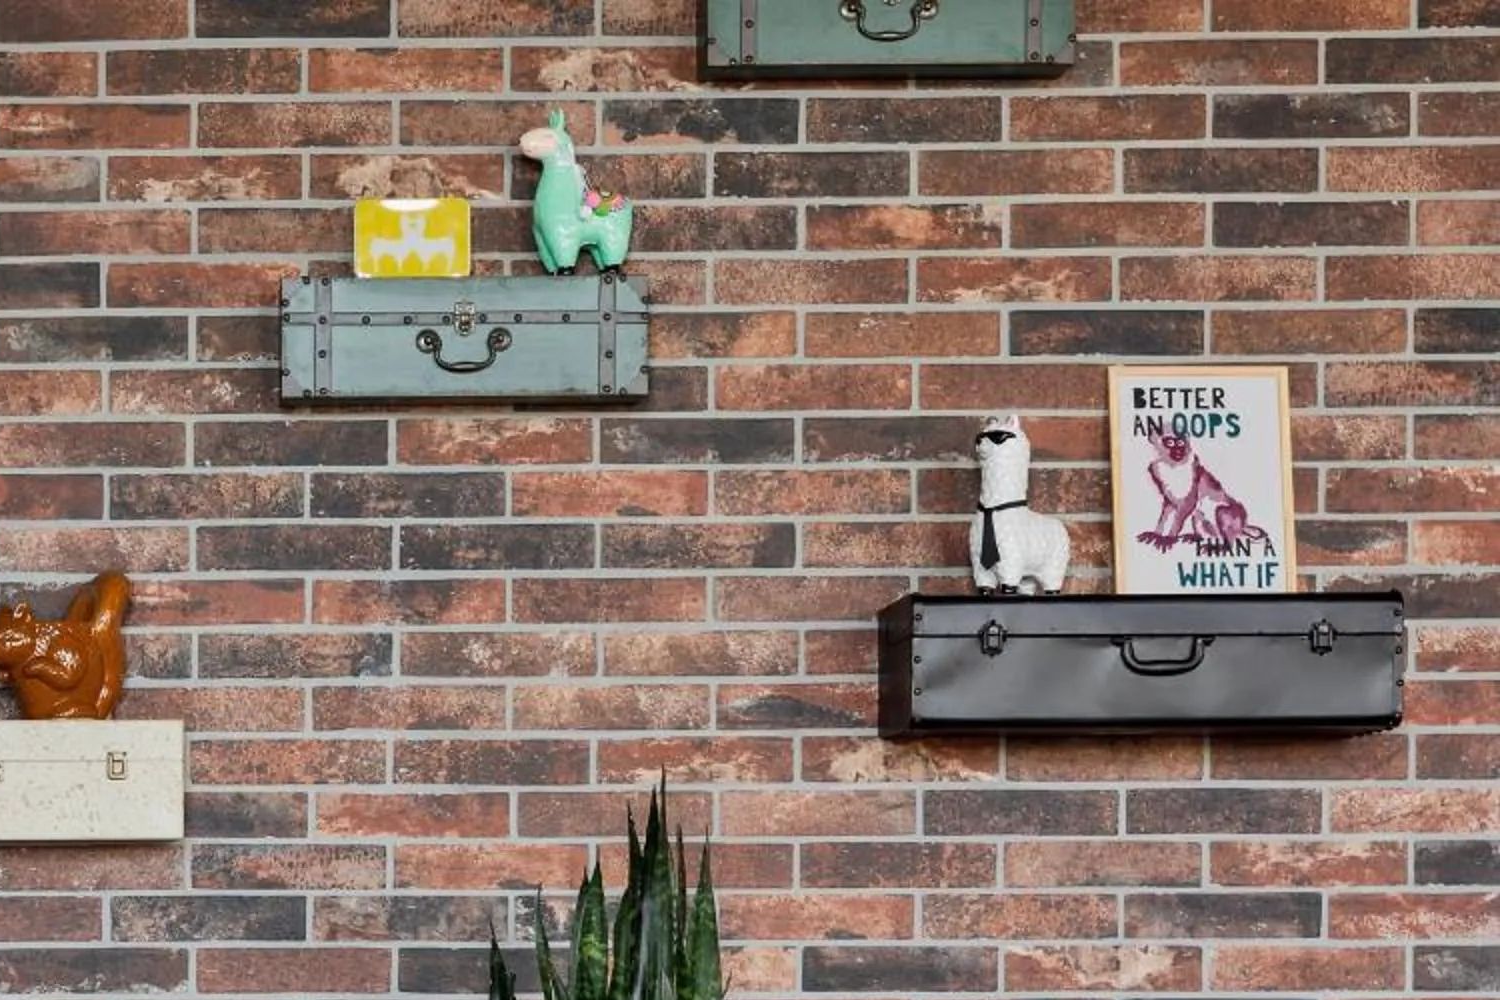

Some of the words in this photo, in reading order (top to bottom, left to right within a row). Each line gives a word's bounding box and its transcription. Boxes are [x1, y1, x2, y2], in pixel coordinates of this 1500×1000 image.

[1133, 387, 1226, 409] BETTER
[1133, 415, 1164, 437] AN
[1172, 412, 1241, 438] OOPS
[1194, 537, 1251, 557] THAN
[1263, 537, 1277, 557] A
[1177, 561, 1249, 587] WHAT
[1257, 561, 1280, 588] IF
